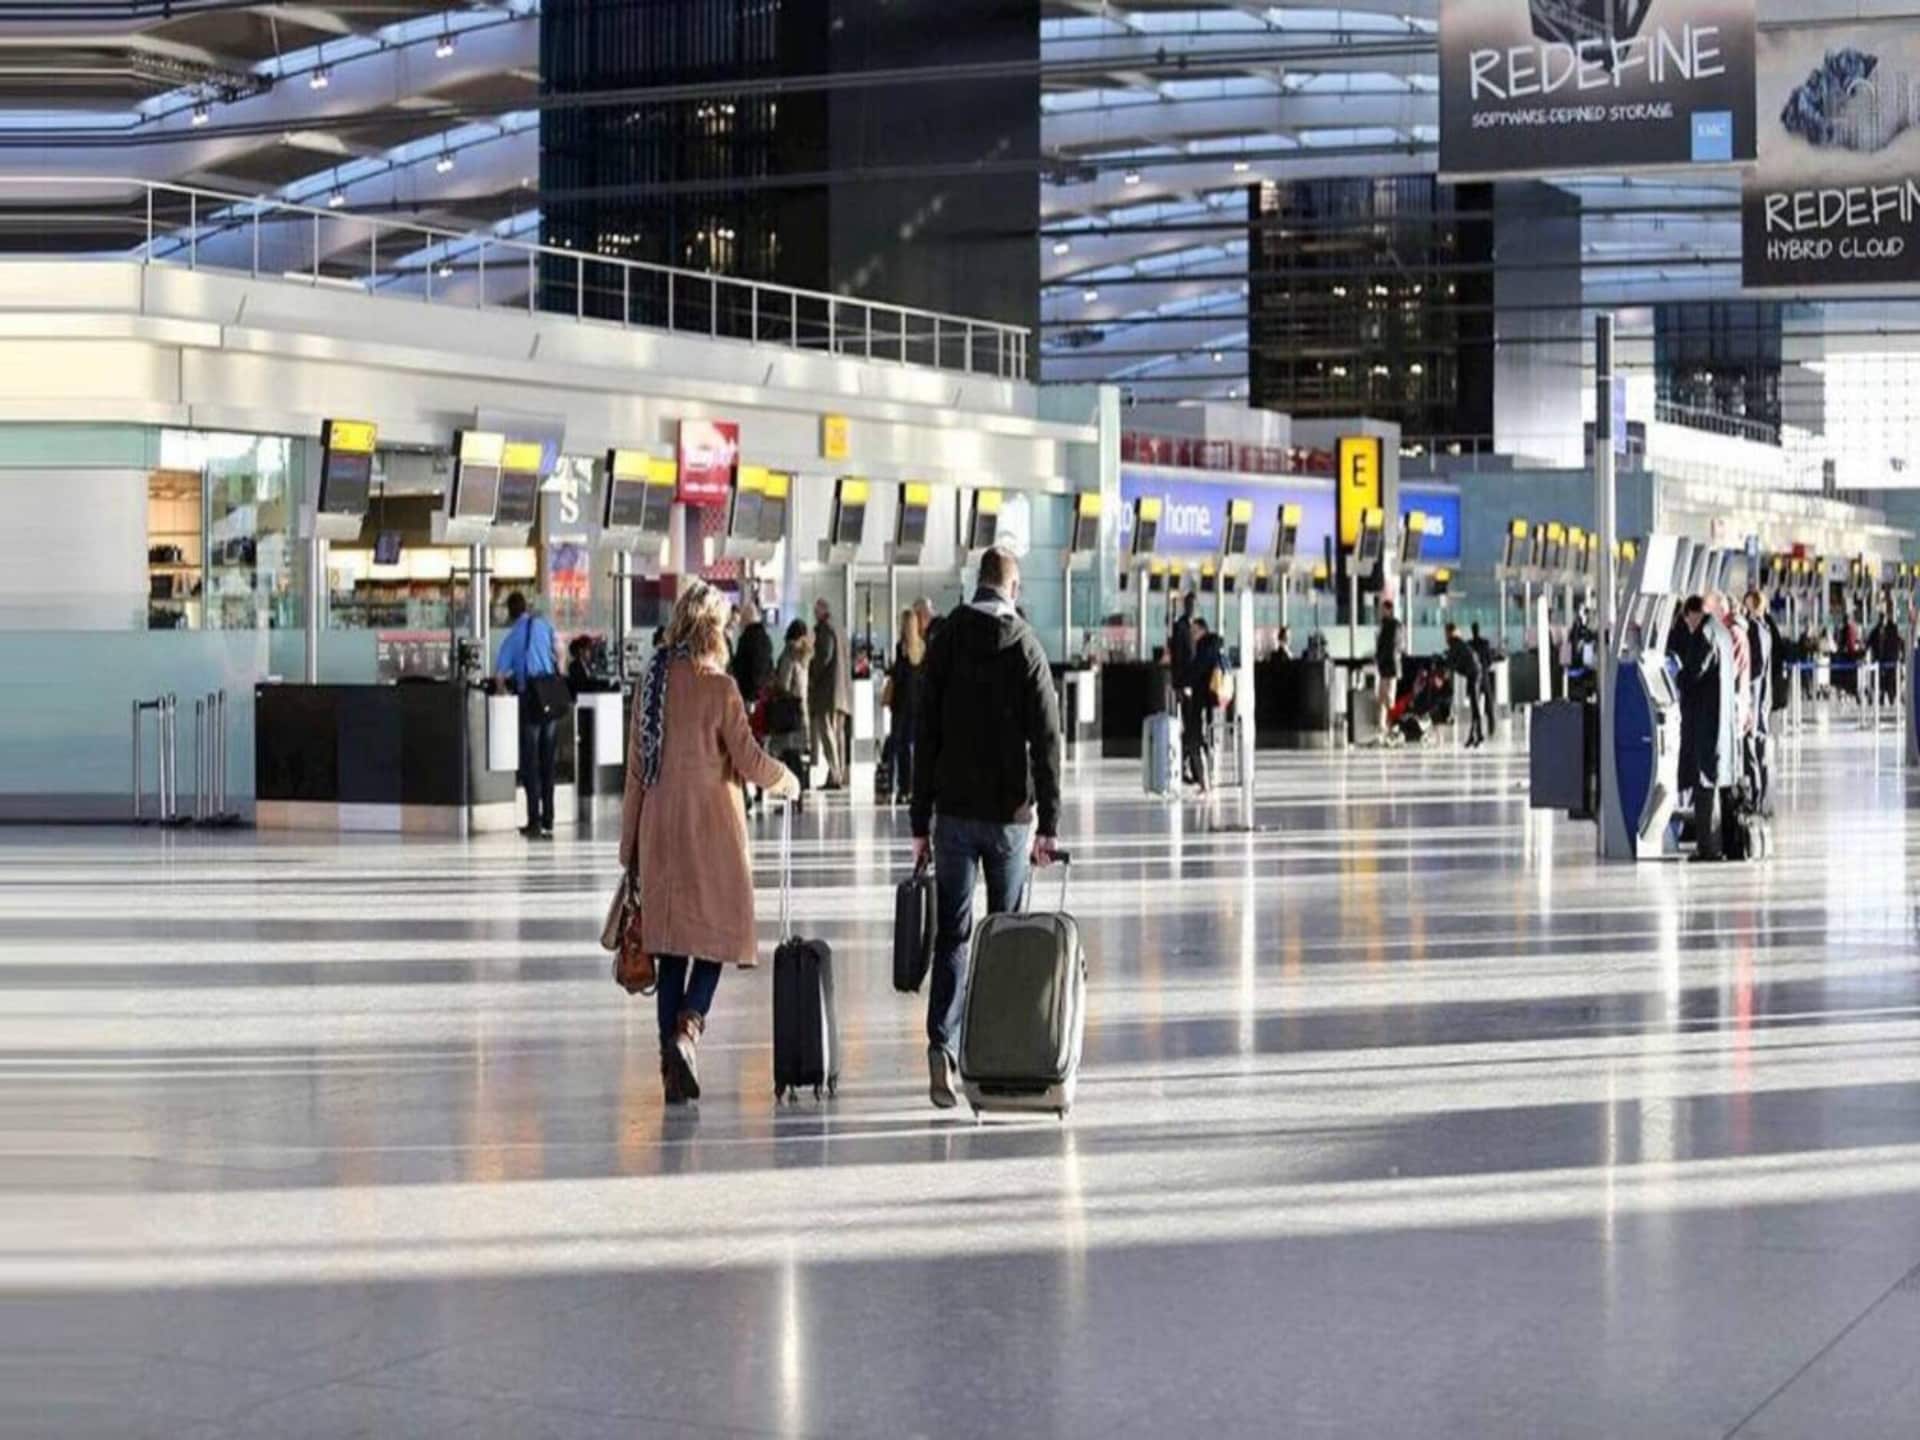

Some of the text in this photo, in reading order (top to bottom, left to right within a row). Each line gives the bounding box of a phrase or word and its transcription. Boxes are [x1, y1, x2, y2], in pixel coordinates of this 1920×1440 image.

[1469, 23, 1726, 100] REDEFINE
[1610, 101, 1674, 122] STORAGE
[1767, 236, 1905, 260] HYBRID CLOUD
[1353, 453, 1367, 487] E
